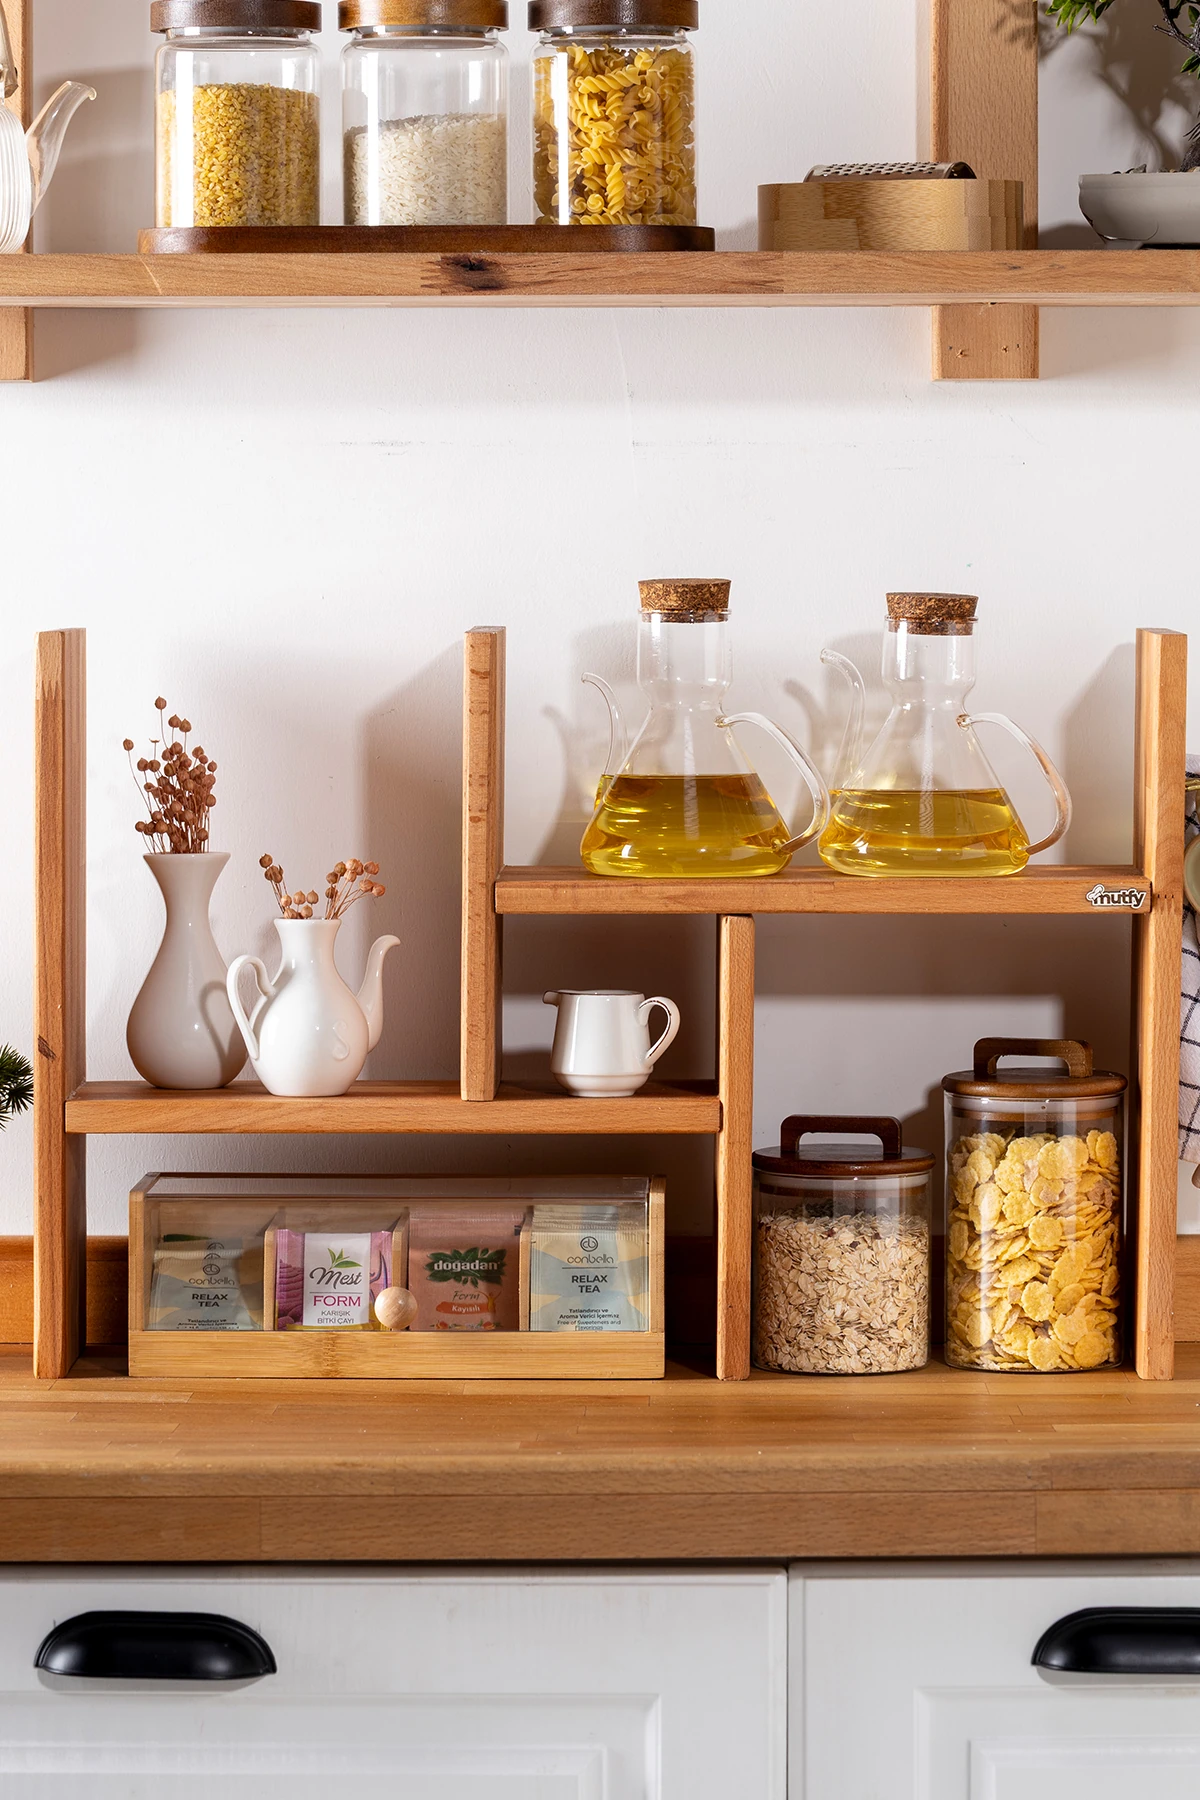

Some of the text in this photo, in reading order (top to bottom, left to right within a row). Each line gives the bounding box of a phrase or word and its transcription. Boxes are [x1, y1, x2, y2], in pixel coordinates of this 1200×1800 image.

[1094, 890, 1144, 907] mutfy
[567, 1254, 613, 1263] conbella
[434, 1260, 498, 1271] doğadan
[572, 1275, 608, 1283] RELAX
[578, 1285, 600, 1293] TEA
[314, 1296, 360, 1306] FORM
[453, 1291, 480, 1301] Form
